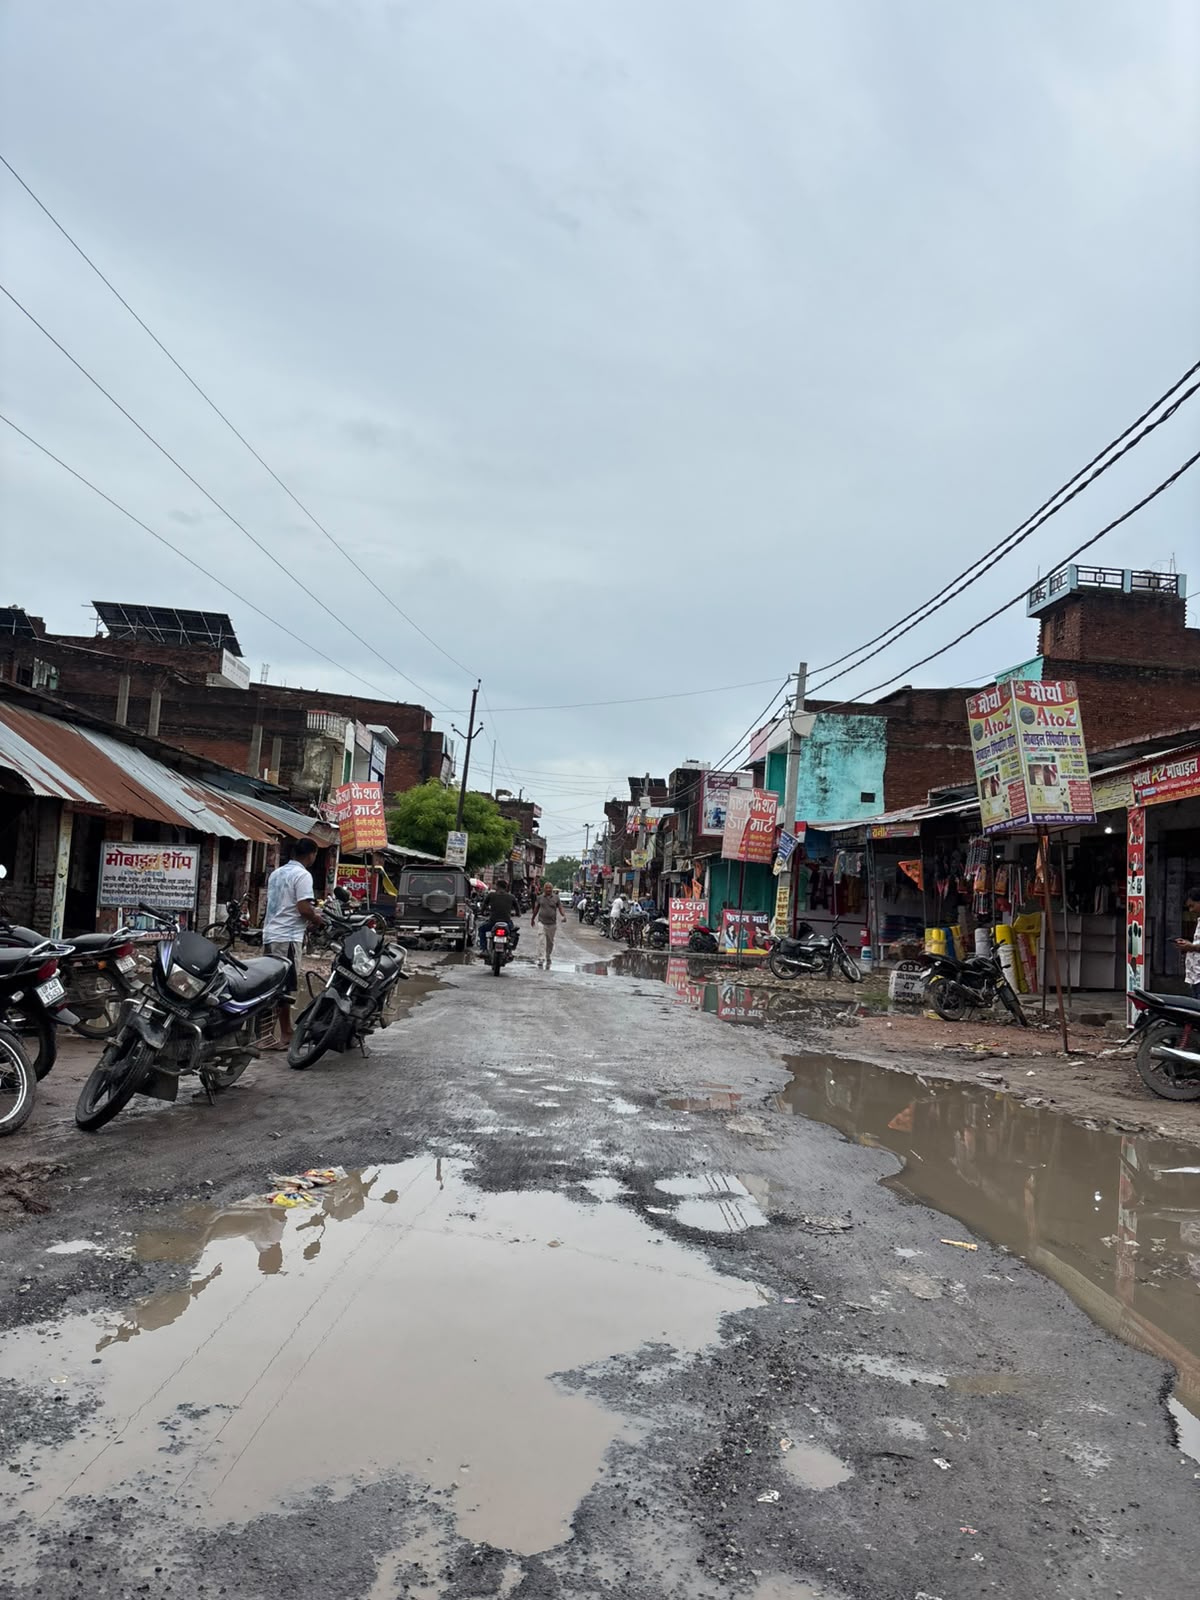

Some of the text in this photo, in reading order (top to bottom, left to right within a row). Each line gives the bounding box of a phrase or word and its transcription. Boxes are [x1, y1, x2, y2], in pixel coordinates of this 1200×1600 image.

[978, 685, 1002, 714] मौर्या
[1029, 681, 1063, 702] मौर्या
[1166, 758, 1198, 778] मोबाइल
[352, 783, 381, 800] फैशन
[354, 801, 382, 816] मार्ट
[751, 791, 777, 815] फैशन
[750, 815, 775, 833] मार्ट
[671, 898, 706, 912] फैशन
[671, 911, 695, 922] मार्ट
[752, 913, 769, 924] मार्ट
